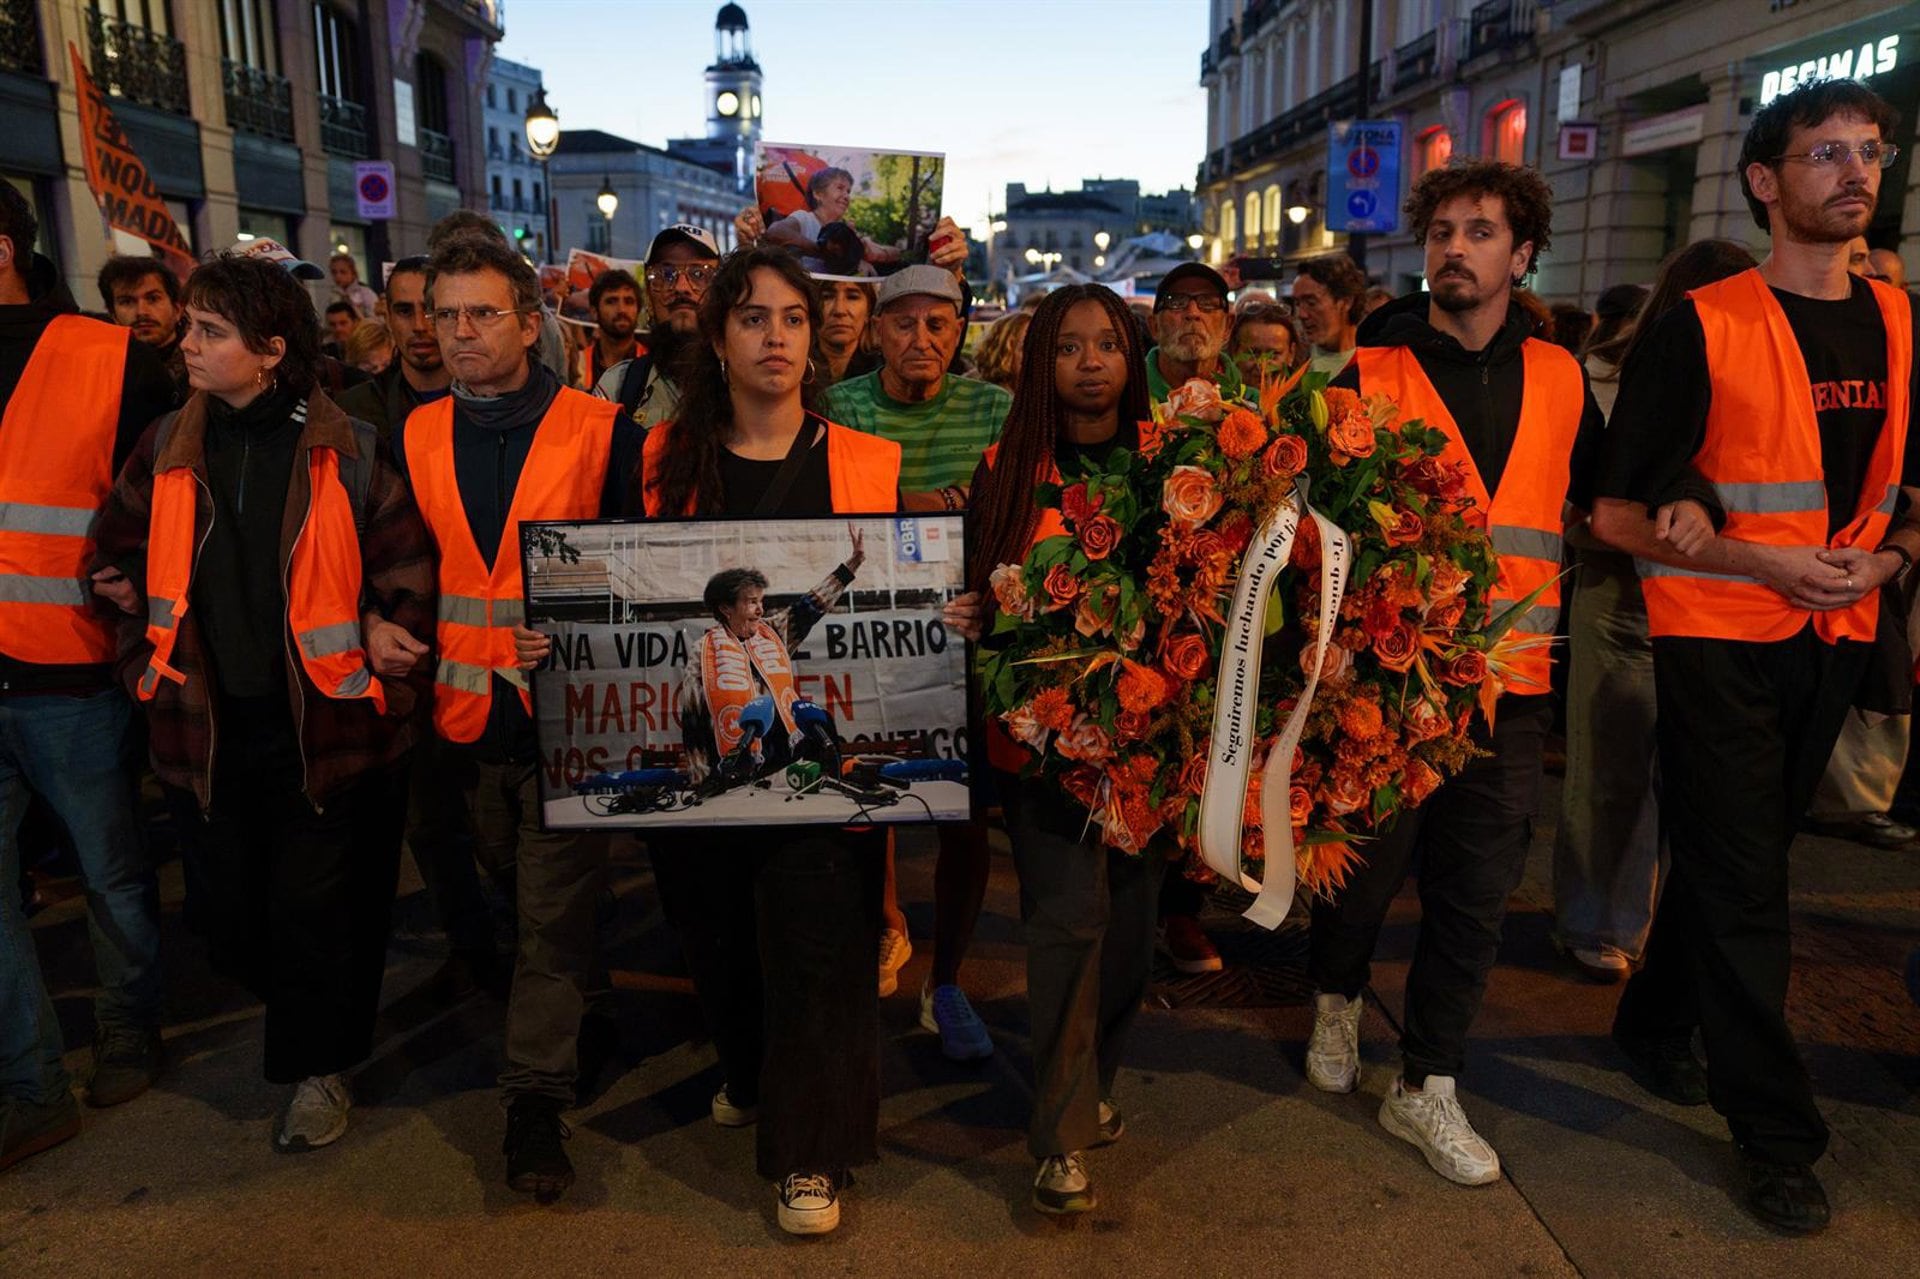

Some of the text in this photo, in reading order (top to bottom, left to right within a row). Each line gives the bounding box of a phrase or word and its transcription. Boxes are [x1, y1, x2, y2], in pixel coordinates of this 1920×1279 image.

[1760, 34, 1900, 105] DECIMAS
[1263, 532, 1287, 560] por
[1332, 537, 1344, 561] Te
[1234, 563, 1265, 653] luchando
[614, 630, 688, 668] VIDA
[825, 620, 947, 660] BARRIO
[1222, 658, 1247, 766] Seguiremos
